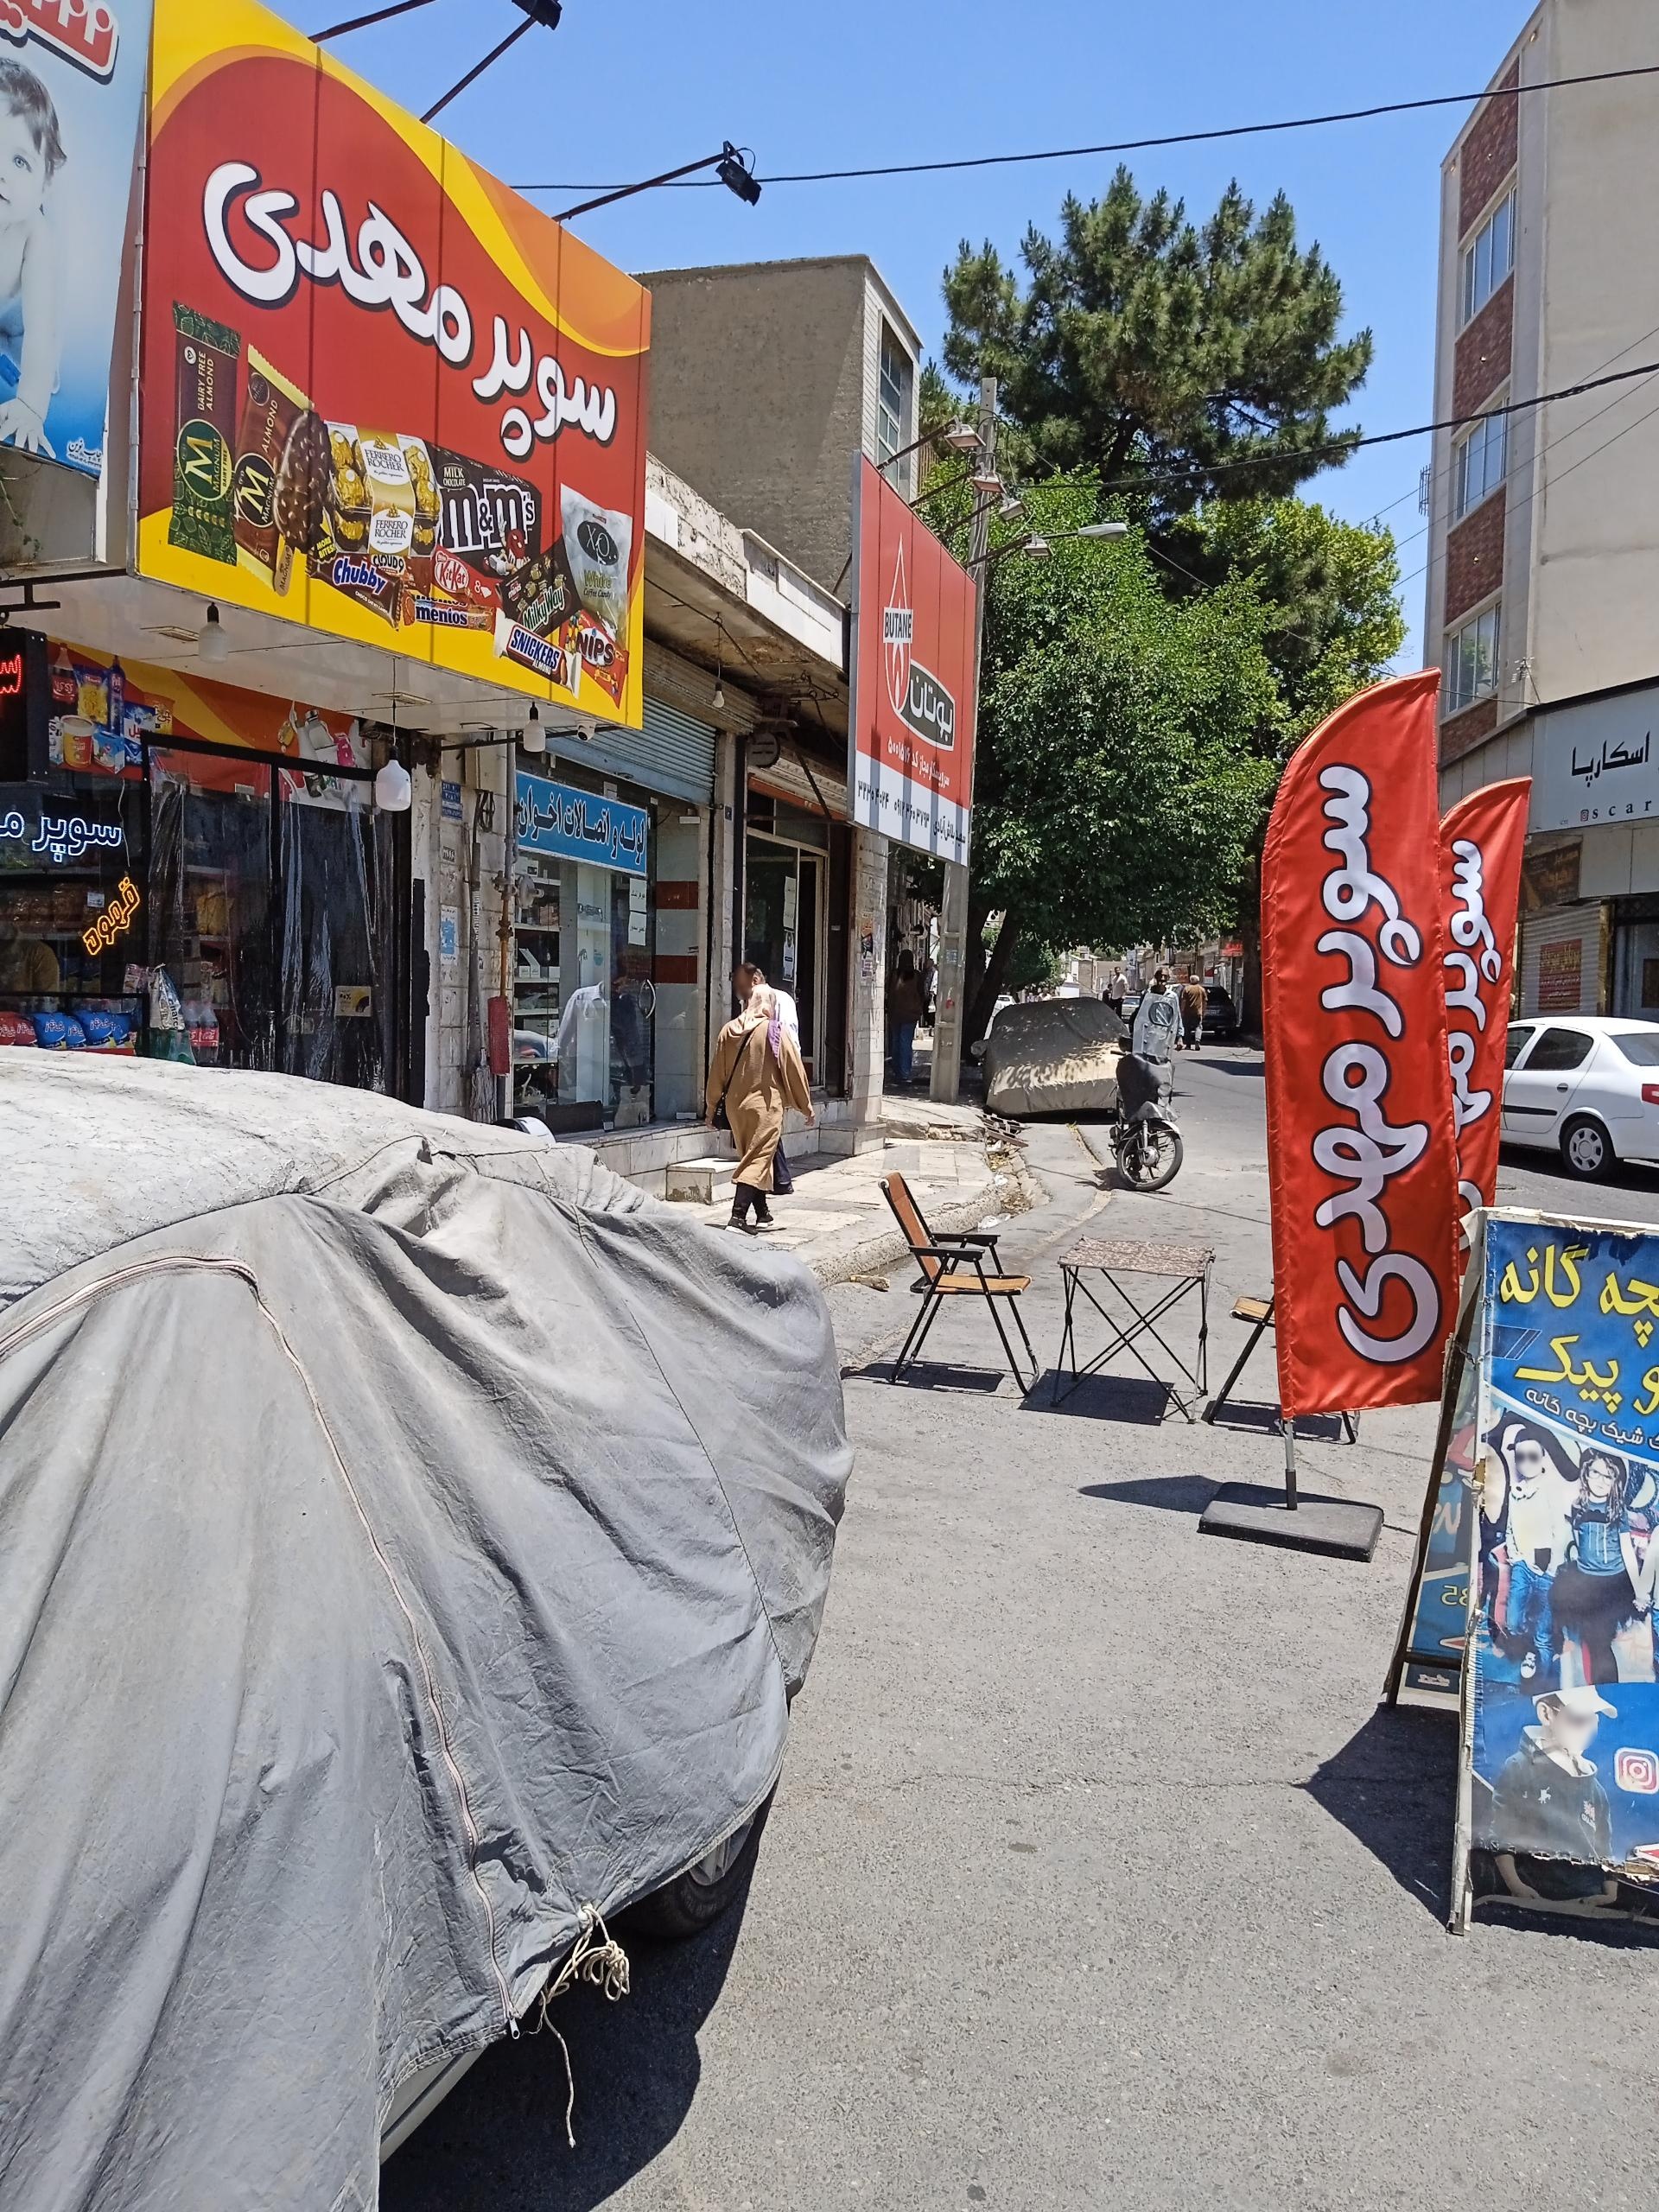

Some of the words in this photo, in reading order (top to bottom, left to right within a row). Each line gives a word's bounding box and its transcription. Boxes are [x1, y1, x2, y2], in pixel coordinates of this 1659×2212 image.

[204, 162, 471, 363] مهدی
[198, 351, 207, 376] FREE
[206, 359, 214, 411] ALMOND
[474, 315, 616, 457] سوپر
[261, 399, 278, 454] ALMOND
[213, 438, 221, 492] MAGNUM
[364, 448, 402, 463] FERRERO
[366, 457, 404, 472] ROCHER
[443, 467, 465, 479] MILK
[442, 476, 466, 486] CHOCOLATE
[261, 476, 276, 523] MAGNUM
[374, 528, 406, 539] ROCHER
[375, 519, 408, 530] FERRERO
[316, 537, 332, 550] MORE
[279, 552, 292, 590] MAGNUM
[334, 556, 387, 594] Chubby
[438, 561, 467, 591] KitKat
[583, 570, 612, 589] White
[583, 588, 598, 598] Coffee
[597, 589, 612, 600] Candy
[416, 606, 468, 626] mentos
[884, 611, 912, 639] BUTANE
[510, 628, 560, 671] SNICKERS
[576, 631, 615, 665] NIPS
[532, 658, 552, 676] ALMOND
[910, 675, 953, 742] بوتان
[911, 750, 918, 768] کد
[1572, 730, 1650, 788] اسکارپا
[518, 784, 563, 842] اخوان
[563, 798, 611, 847] اتصالات
[32, 816, 122, 862] سوپر
[610, 825, 619, 860] و
[618, 815, 645, 865] لوله
[1317, 763, 1422, 1038] سوپر
[1444, 838, 1503, 1033] سوپر
[1313, 1041, 1441, 1366] مهدی
[1499, 1244, 1590, 1308] گانه
[1515, 1335, 1623, 1414] پیک
[1525, 1389, 1560, 1417] گانه
[1565, 1408, 1598, 1434] بچه
[1601, 1422, 1644, 1446] شیک
